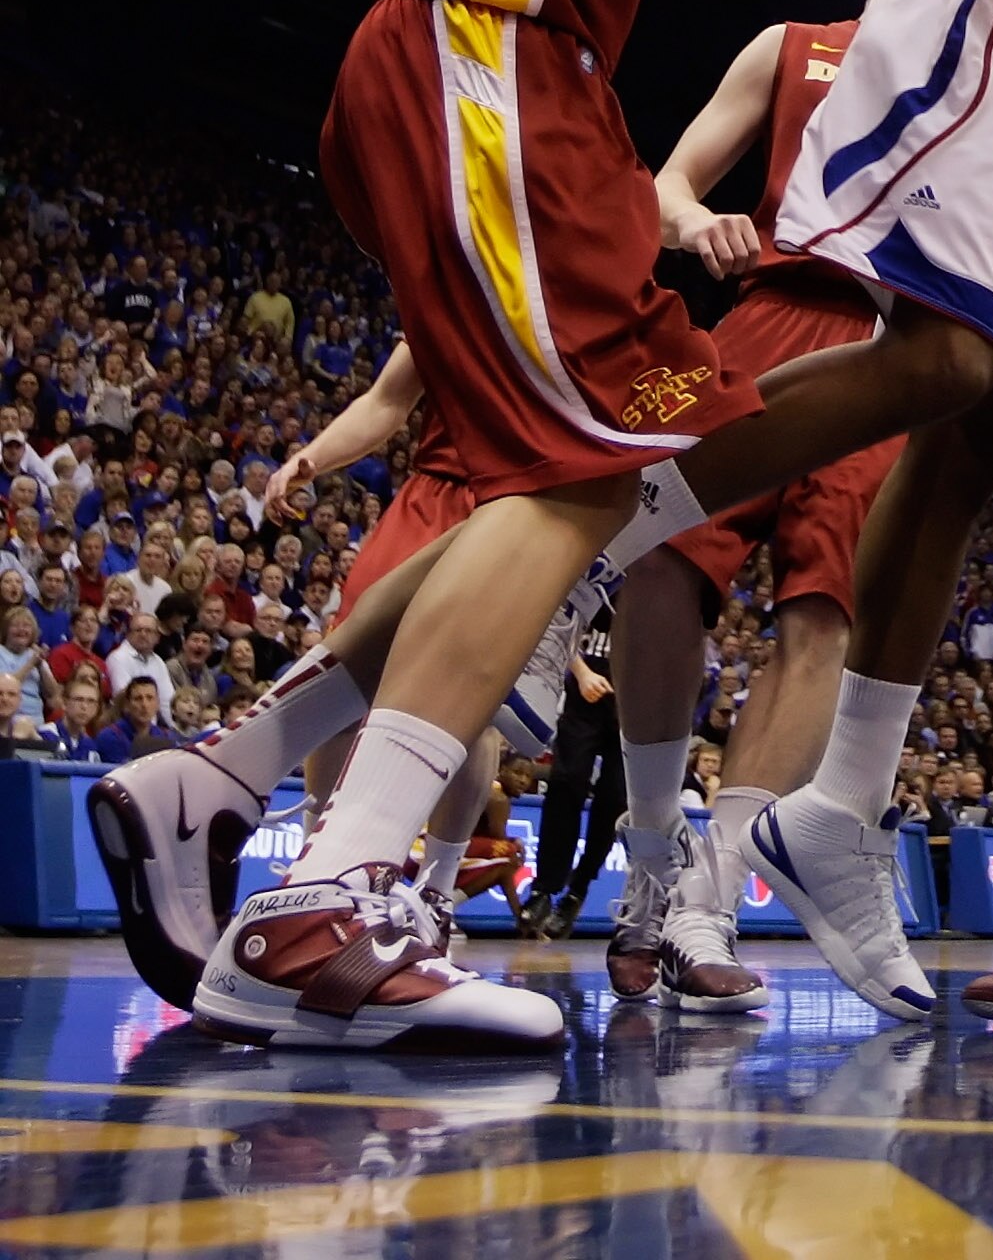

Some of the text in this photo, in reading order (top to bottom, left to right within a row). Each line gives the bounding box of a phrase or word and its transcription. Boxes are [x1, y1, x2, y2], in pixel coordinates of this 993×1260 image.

[622, 366, 713, 432] STATE
[242, 891, 322, 921] DARIUS
[208, 967, 239, 992] DKS
